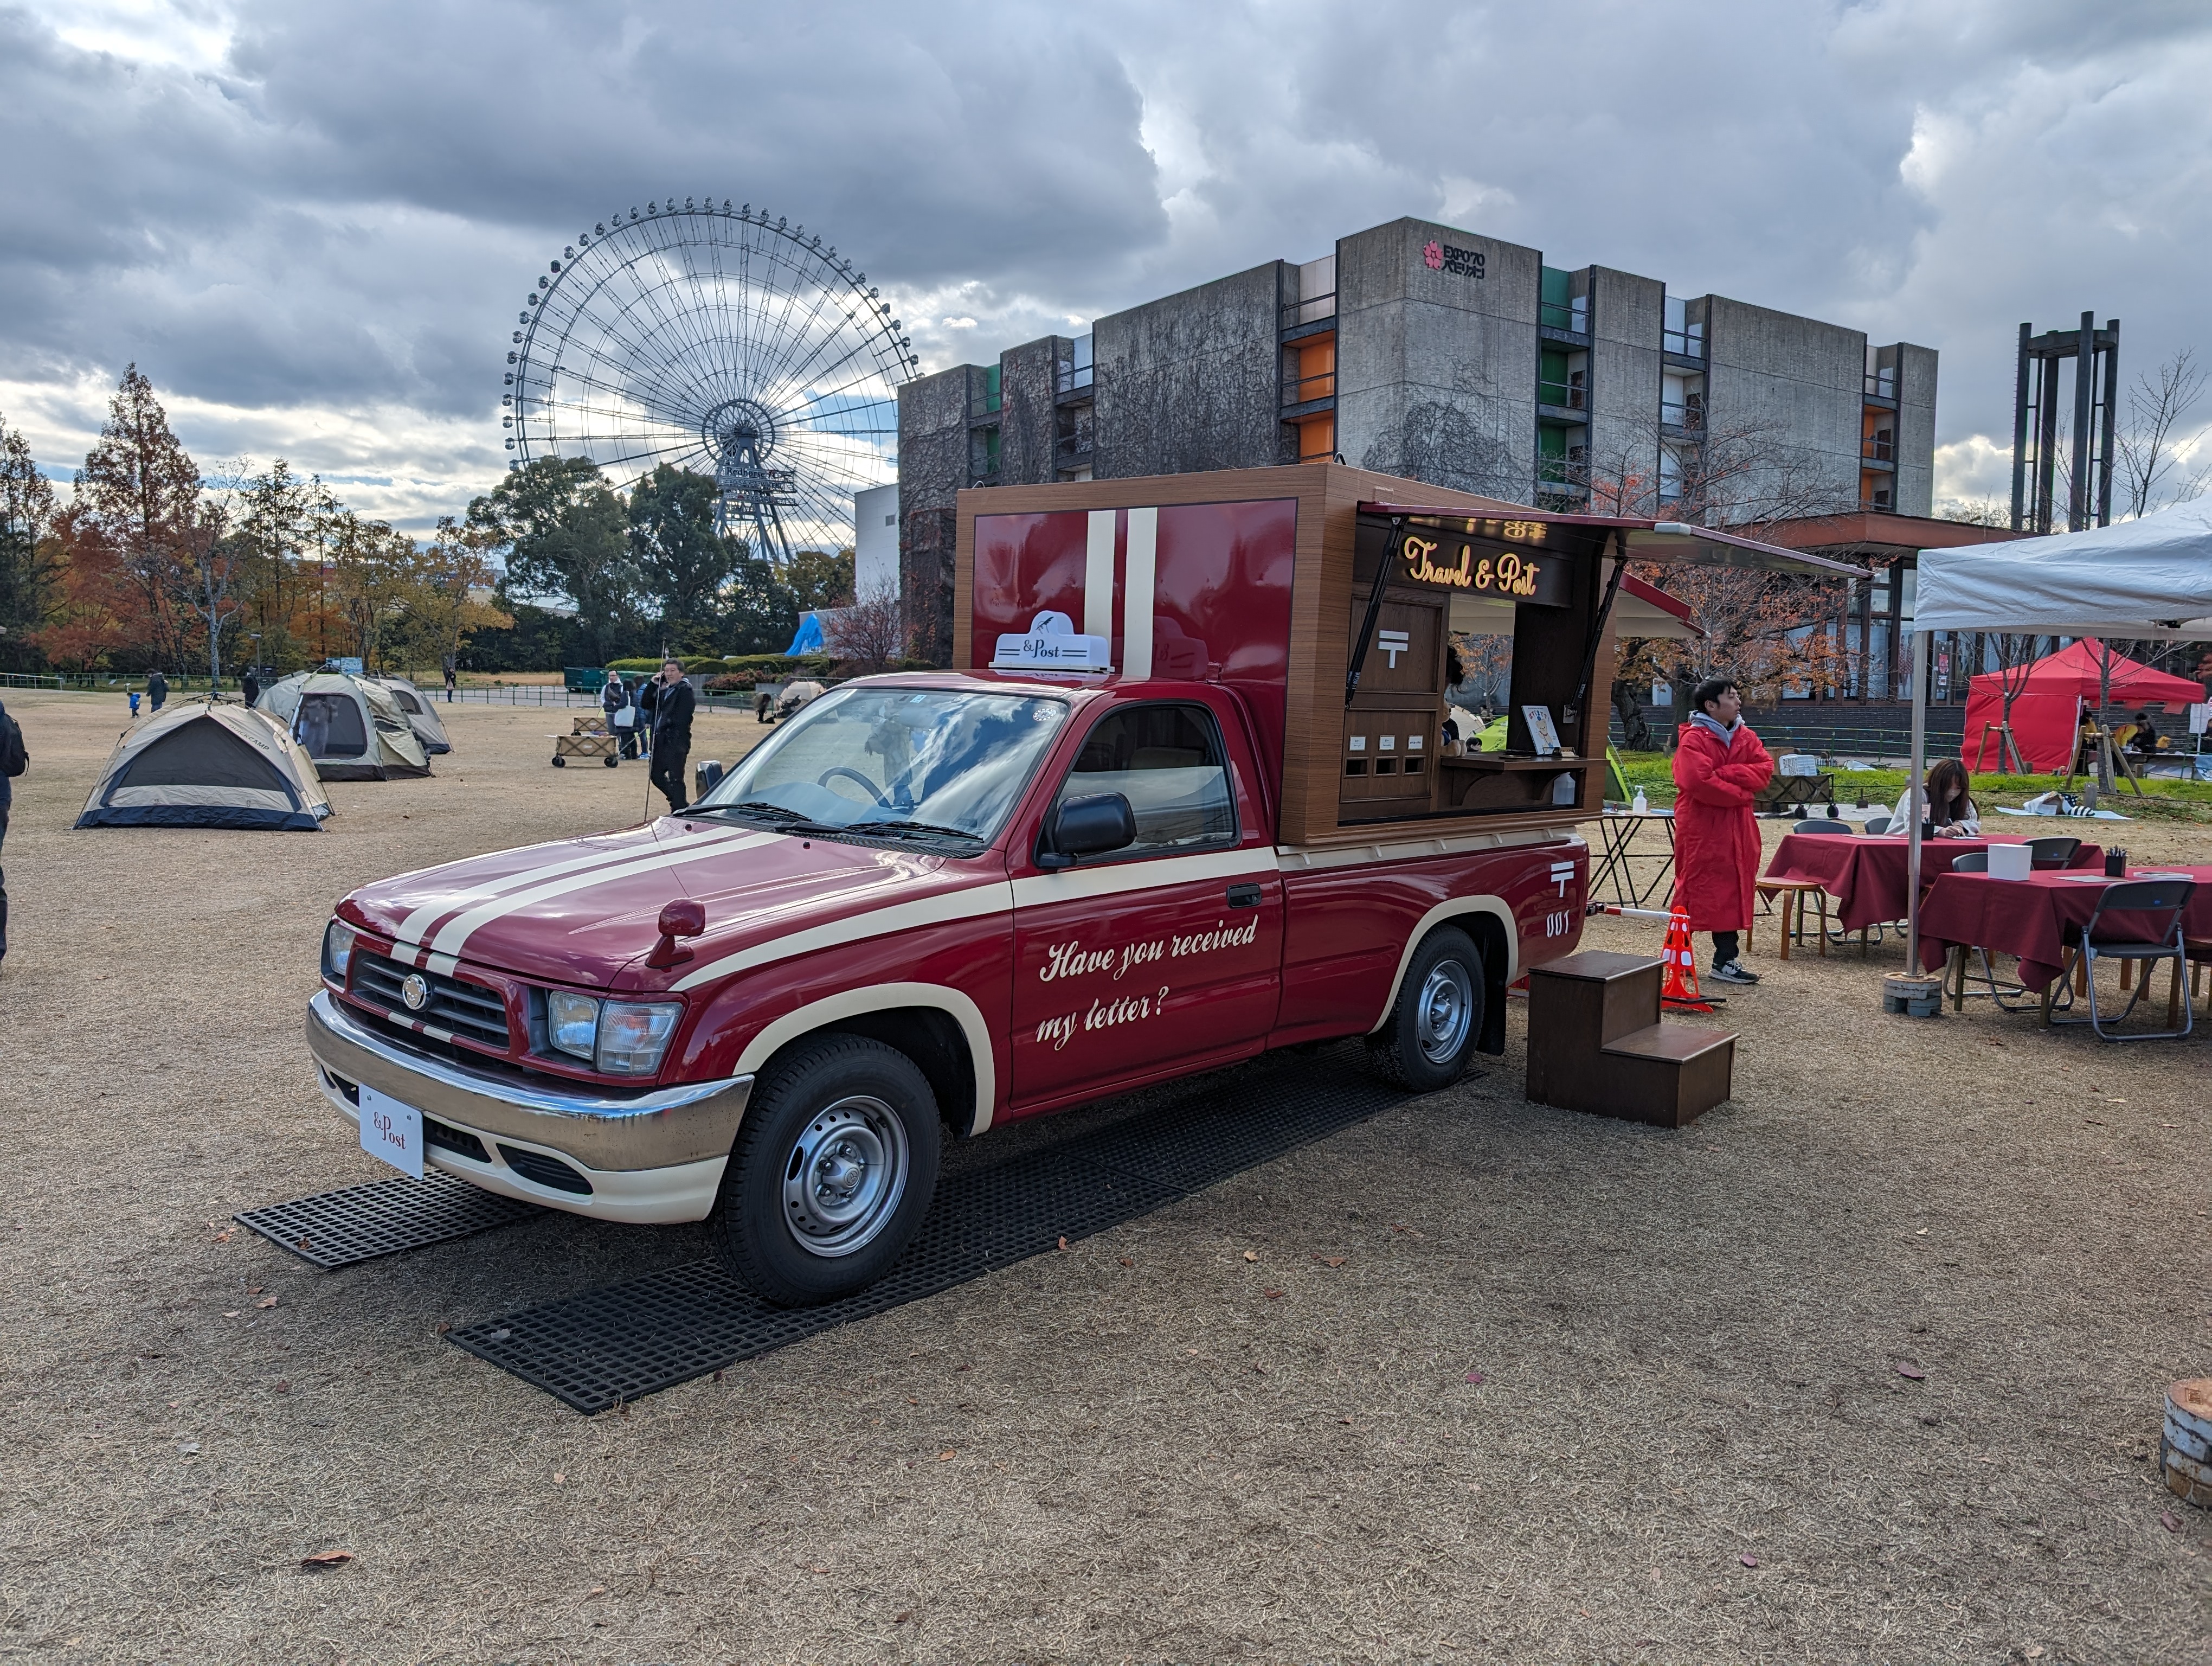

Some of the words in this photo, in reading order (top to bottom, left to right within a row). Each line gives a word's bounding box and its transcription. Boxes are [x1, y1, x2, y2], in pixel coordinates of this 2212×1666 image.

[1442, 259, 1484, 279] パビリオン
[726, 467, 765, 478] Redhorse
[1404, 536, 1472, 587] Travel
[1475, 559, 1495, 589] &
[1497, 553, 1540, 595] Post
[229, 724, 269, 751] QUICKCAMP
[1546, 909, 1570, 938] 001
[1039, 940, 1116, 982] Have
[1113, 940, 1165, 981] you
[1169, 913, 1258, 957] received
[1035, 1011, 1078, 1051] my
